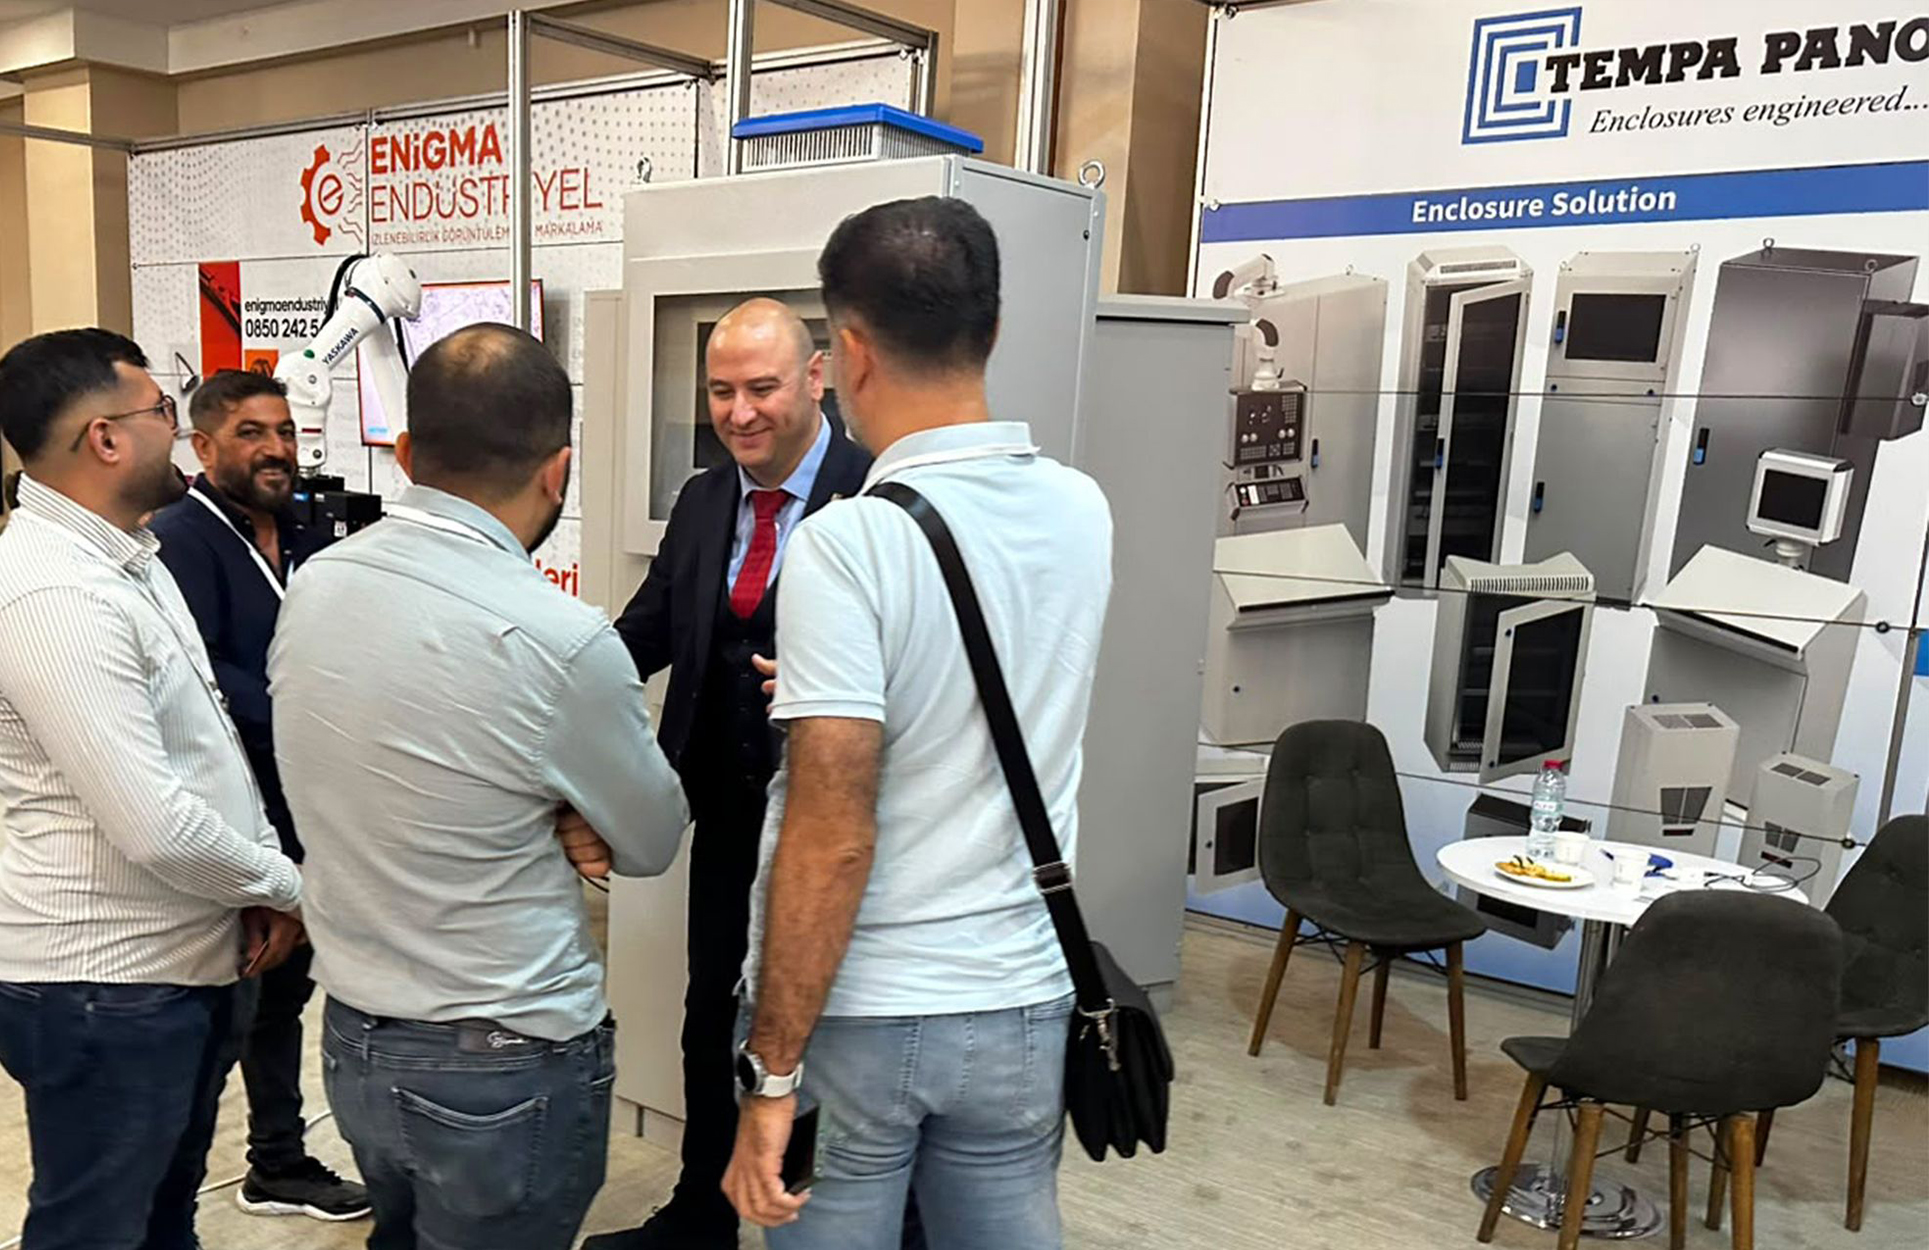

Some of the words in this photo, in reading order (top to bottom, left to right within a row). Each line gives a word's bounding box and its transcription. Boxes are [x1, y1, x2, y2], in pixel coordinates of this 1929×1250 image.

[1546, 38, 1740, 92] TEMPA
[1760, 17, 1929, 74] PANO
[1589, 105, 1735, 133] Enclosures
[1412, 197, 1544, 223] Enclosure
[1551, 186, 1677, 216] Solution
[245, 318, 279, 338] 0850
[281, 318, 307, 338] 242
[321, 327, 359, 365] YASKAWA
